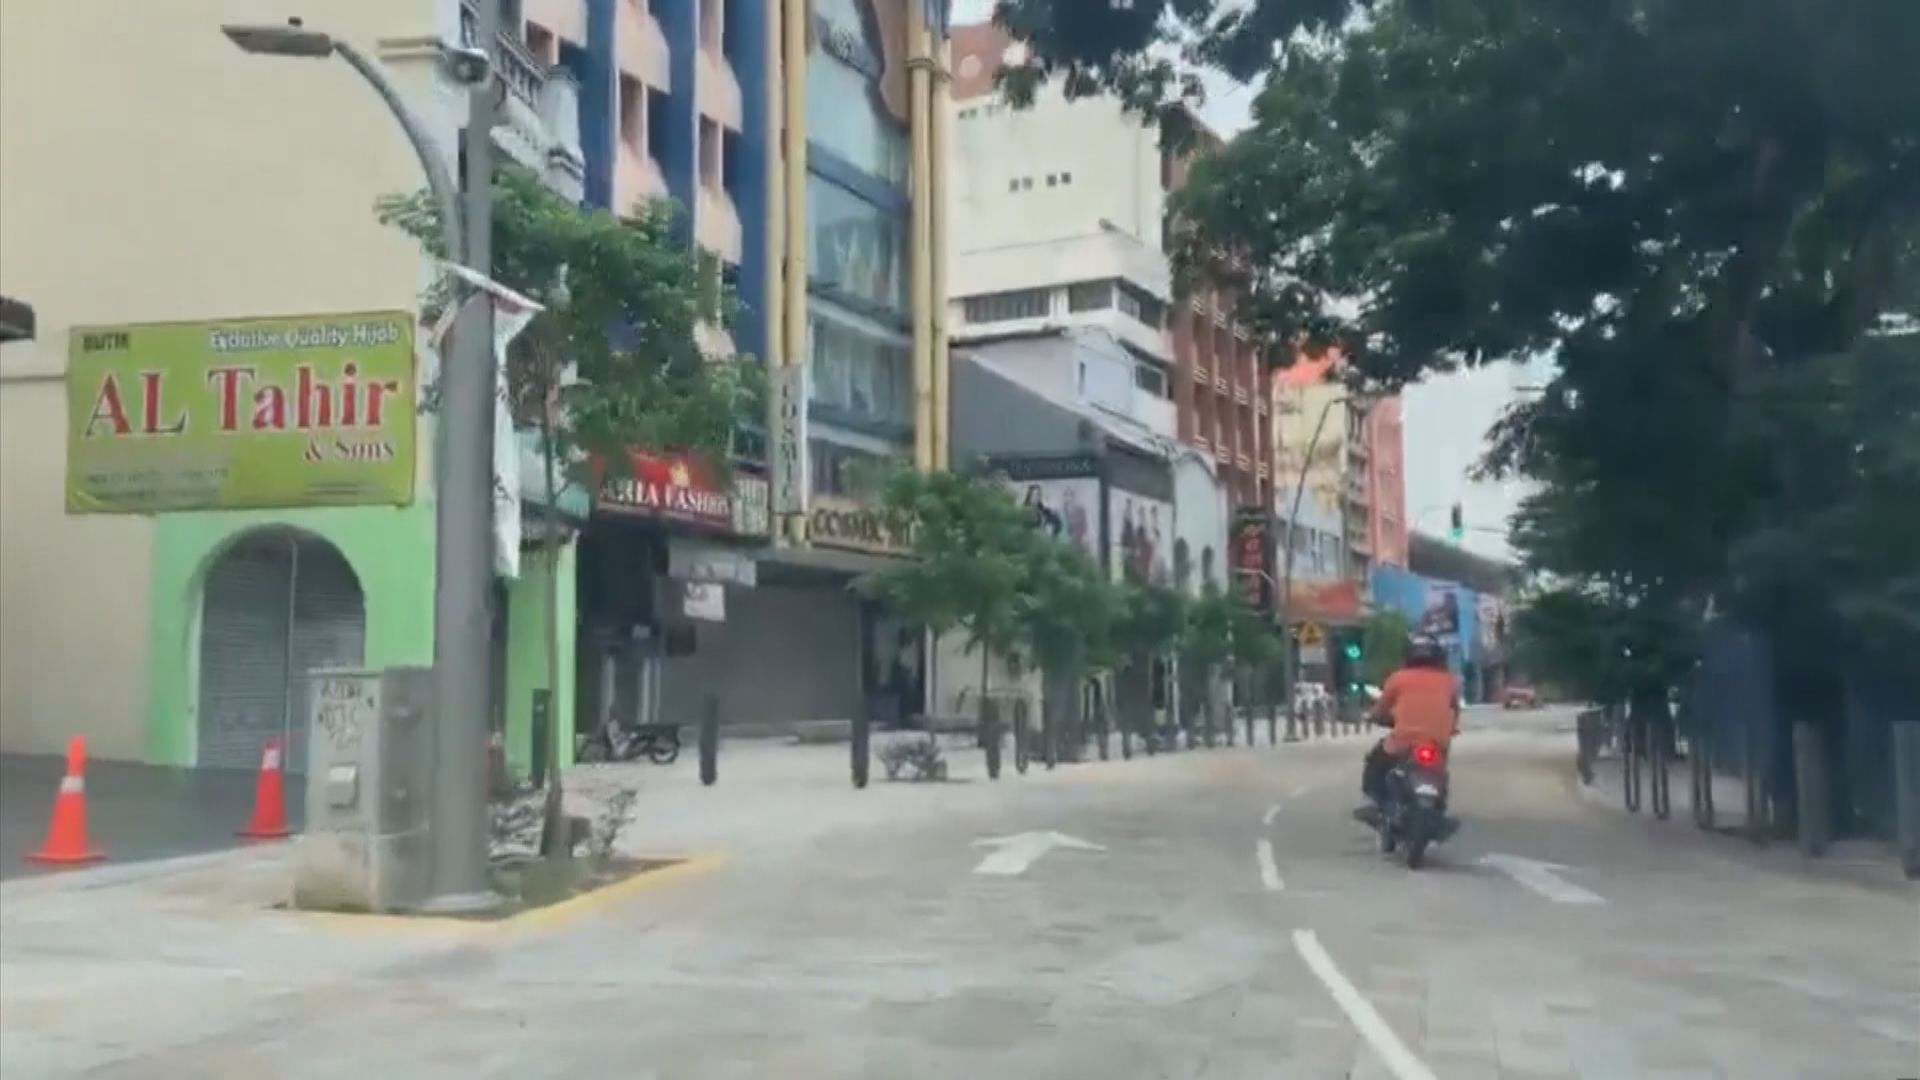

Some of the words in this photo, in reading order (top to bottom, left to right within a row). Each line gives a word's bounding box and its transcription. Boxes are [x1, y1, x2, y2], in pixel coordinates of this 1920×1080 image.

[285, 323, 348, 348] Quality
[352, 320, 400, 346] Hijab
[85, 371, 187, 438] AL
[207, 362, 398, 432] Tahir
[304, 439, 324, 463] &
[334, 438, 395, 461] Sons
